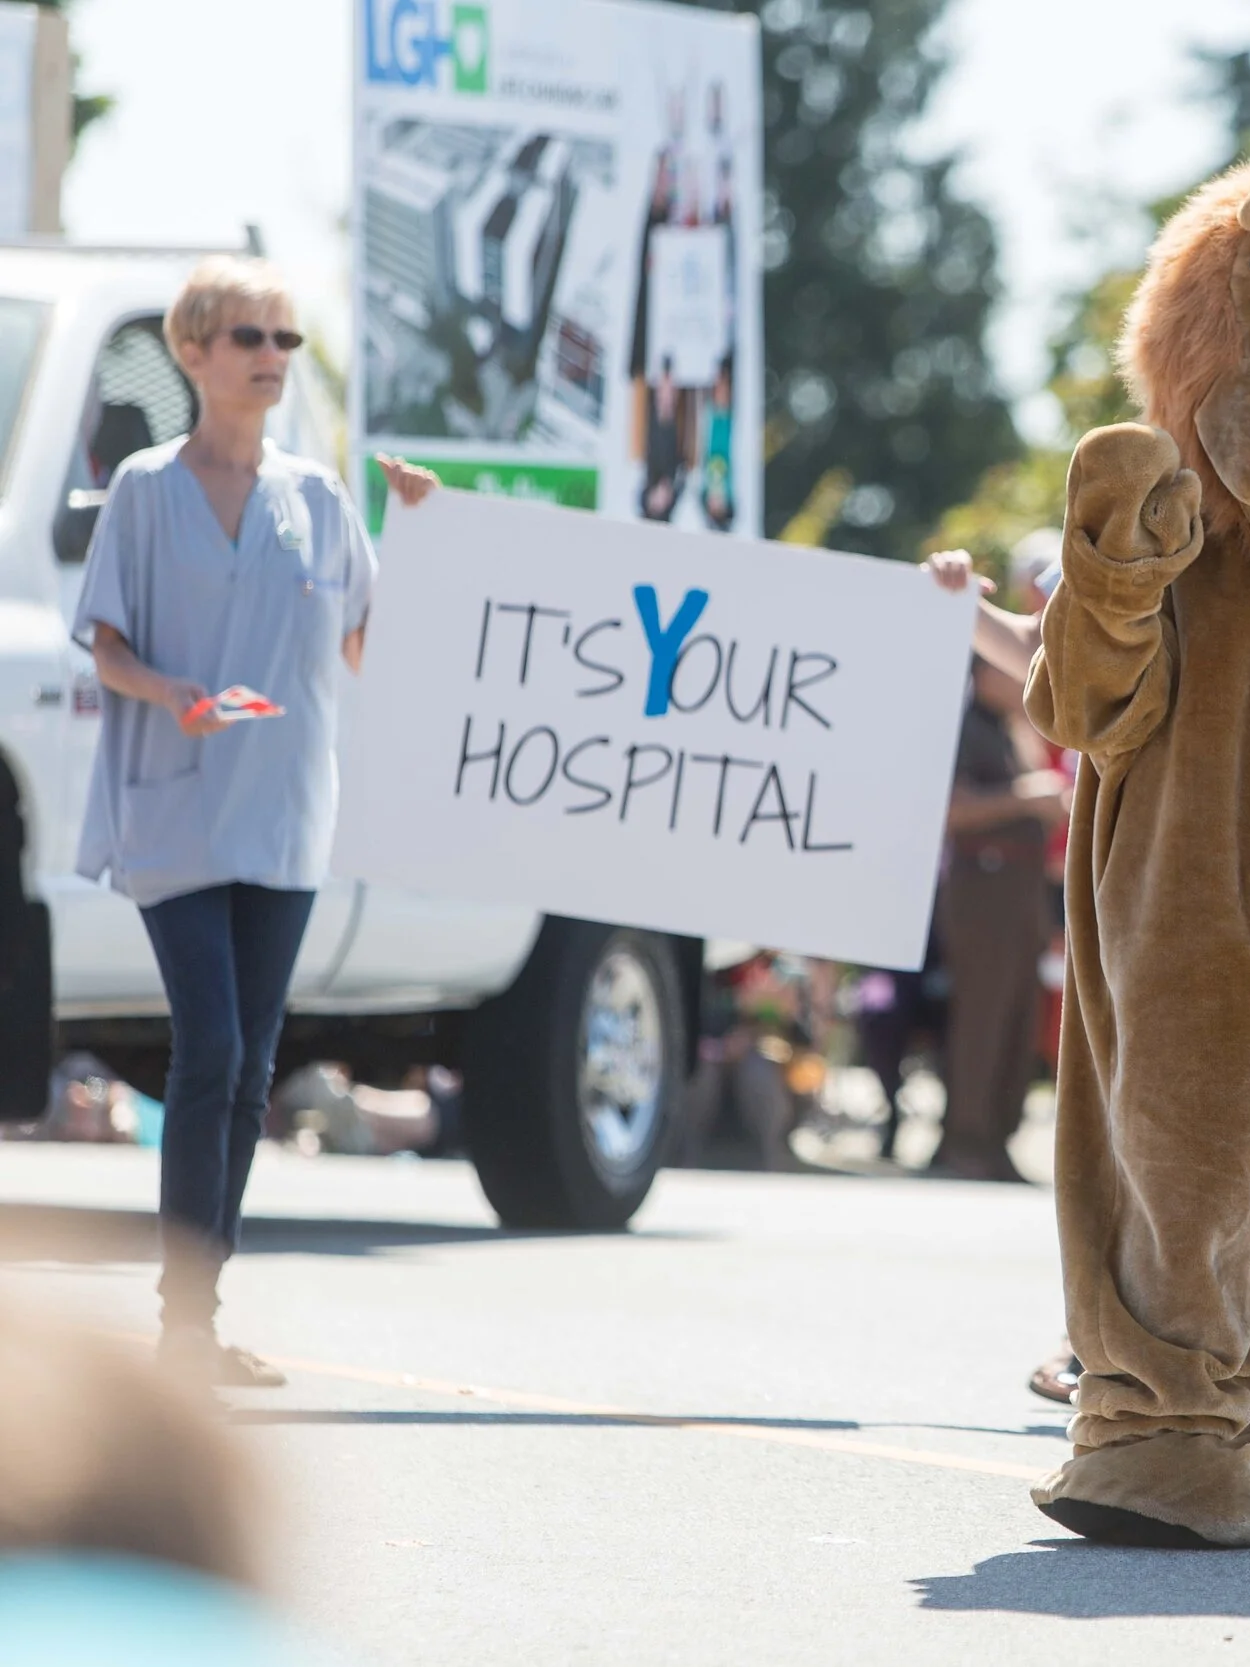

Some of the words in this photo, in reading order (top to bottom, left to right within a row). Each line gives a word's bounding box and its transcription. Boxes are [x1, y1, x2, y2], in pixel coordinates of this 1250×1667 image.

[474, 595, 627, 700] IT'S
[632, 583, 838, 731] YOUR
[454, 713, 855, 853] HOSPITAL
